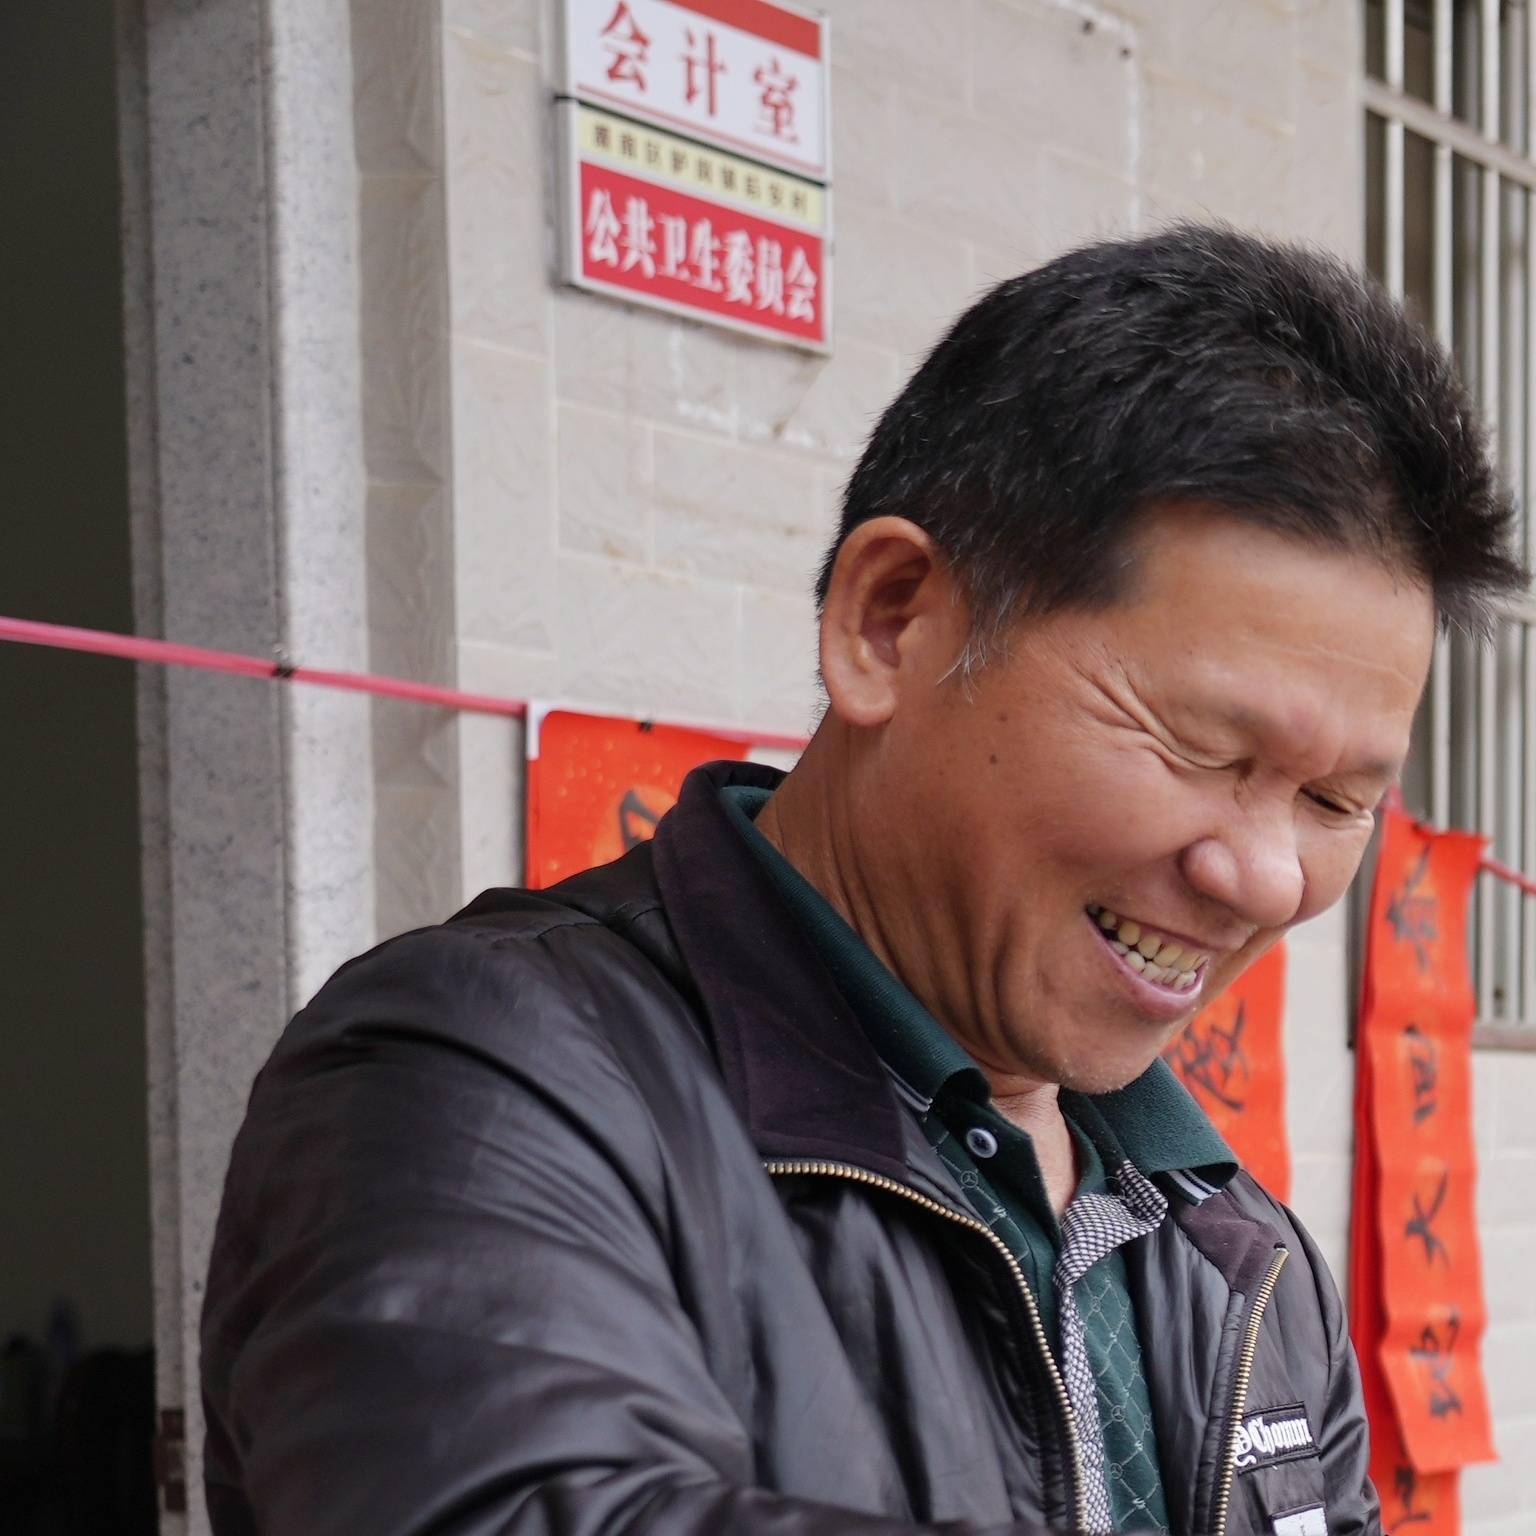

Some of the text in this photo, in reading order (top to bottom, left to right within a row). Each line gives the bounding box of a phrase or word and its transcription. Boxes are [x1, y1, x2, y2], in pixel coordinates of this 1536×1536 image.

[600, 0, 799, 143] 会计室
[585, 187, 818, 322] 公共卫生委员会
